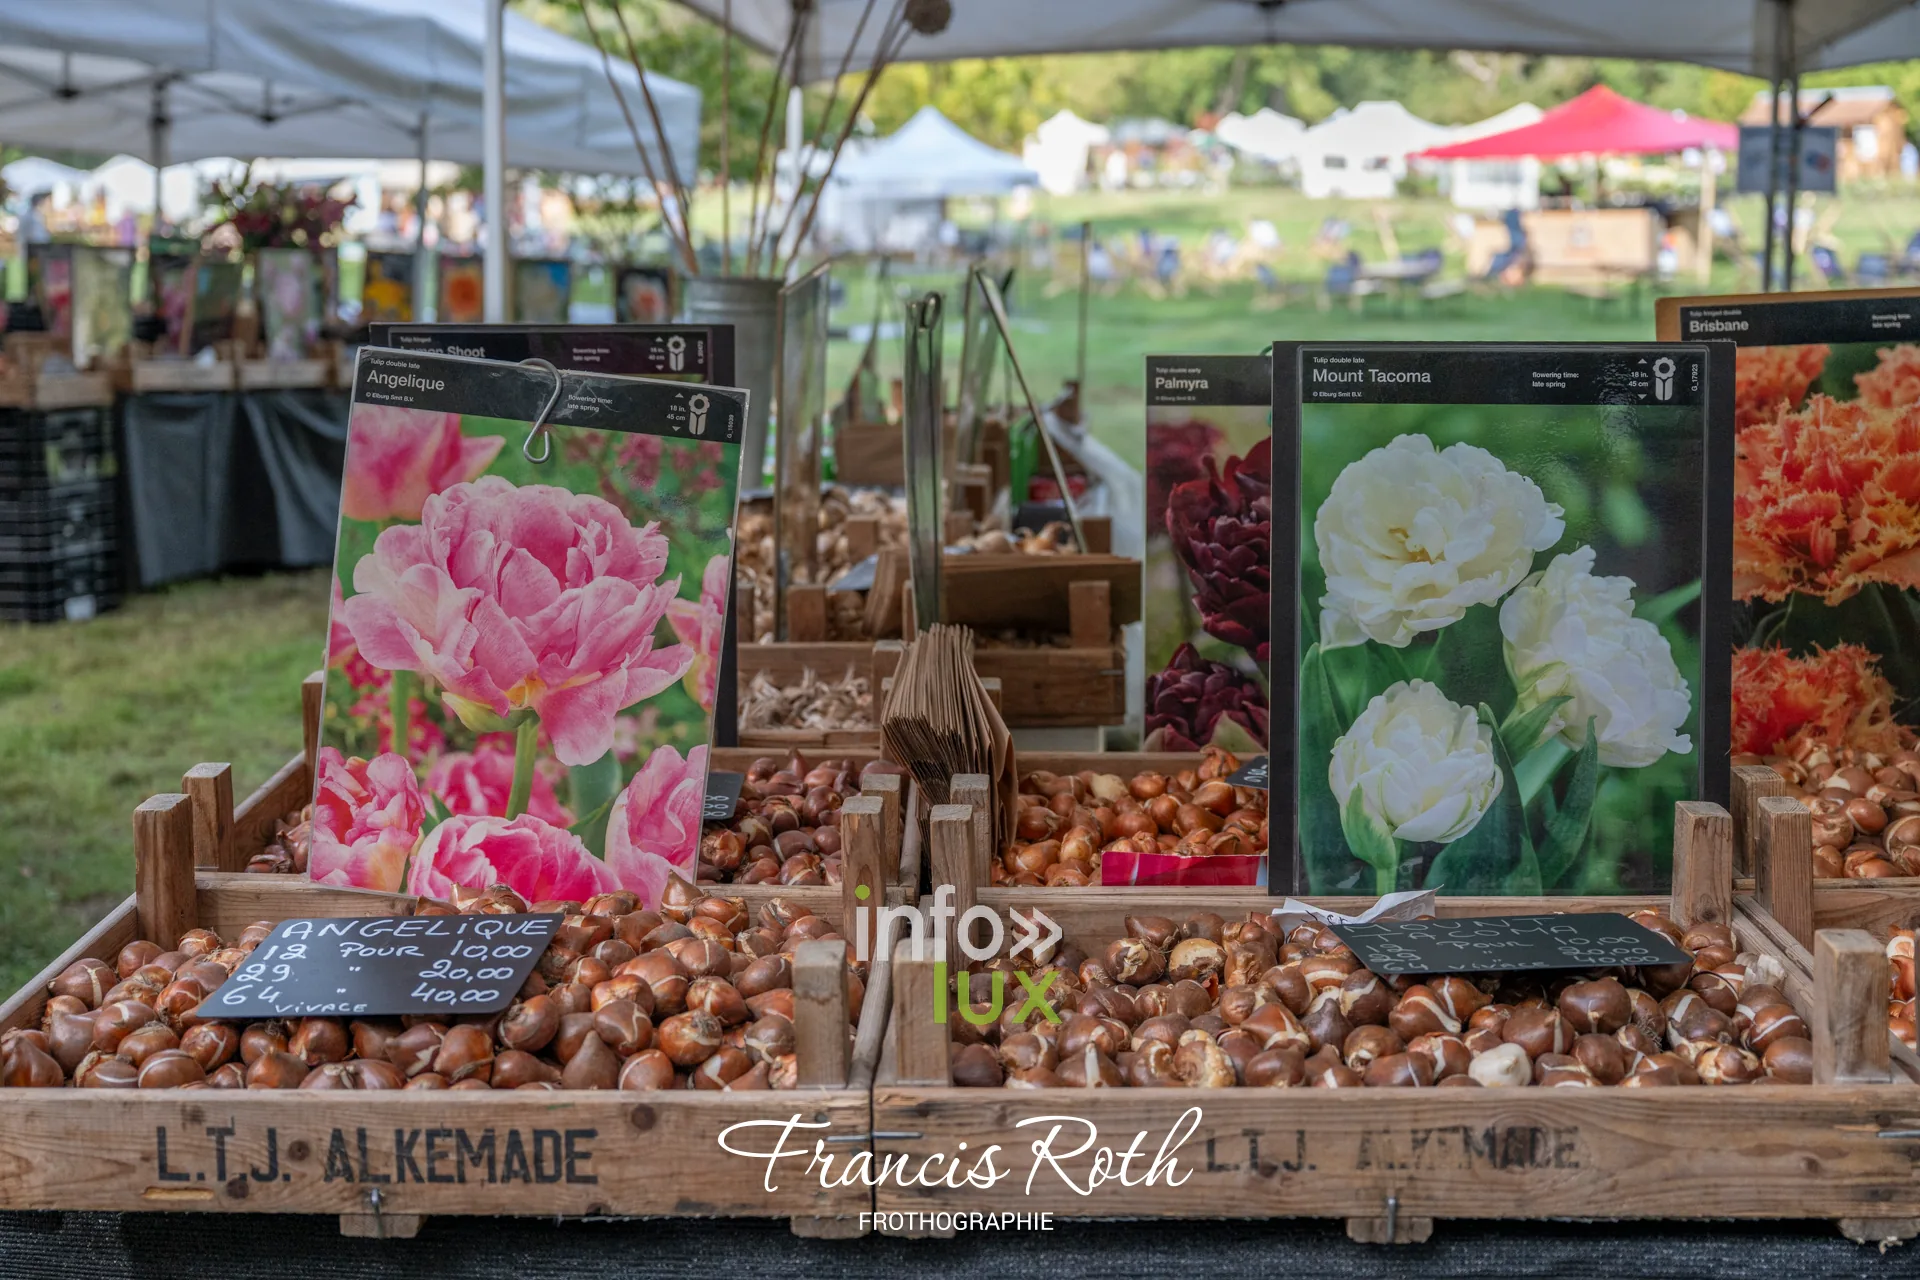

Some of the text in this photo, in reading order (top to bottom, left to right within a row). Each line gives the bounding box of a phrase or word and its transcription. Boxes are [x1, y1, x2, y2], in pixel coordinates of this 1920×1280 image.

[1690, 319, 1749, 333] Brisbane
[447, 346, 486, 358] Shoot
[370, 358, 420, 370] Tulip double late
[366, 369, 445, 392] Angelique
[1313, 368, 1431, 383] Mount Tacoma
[1532, 371, 1562, 379] flowering
[1691, 363, 1699, 391] G_17923
[1155, 376, 1209, 391] Palmyra
[1545, 381, 1566, 389] spring
[568, 394, 596, 404] flowering
[580, 405, 600, 413] spring
[1343, 917, 1555, 933] MOUNT
[1351, 925, 1578, 942] TACOMA
[263, 944, 307, 960] 12
[450, 939, 533, 959] 10,00
[1366, 943, 1416, 953] 12
[1554, 936, 1640, 946] 10,00
[1558, 946, 1649, 956] 20,00
[418, 959, 514, 981] 20,00
[1383, 962, 1429, 971] 64
[1574, 955, 1660, 964] 40,00
[222, 984, 280, 1005] 64
[410, 981, 500, 1004] 40,00
[156, 1125, 599, 1184] L.T.J. ALKEMADE
[1355, 1125, 1580, 1171] AKMADE
